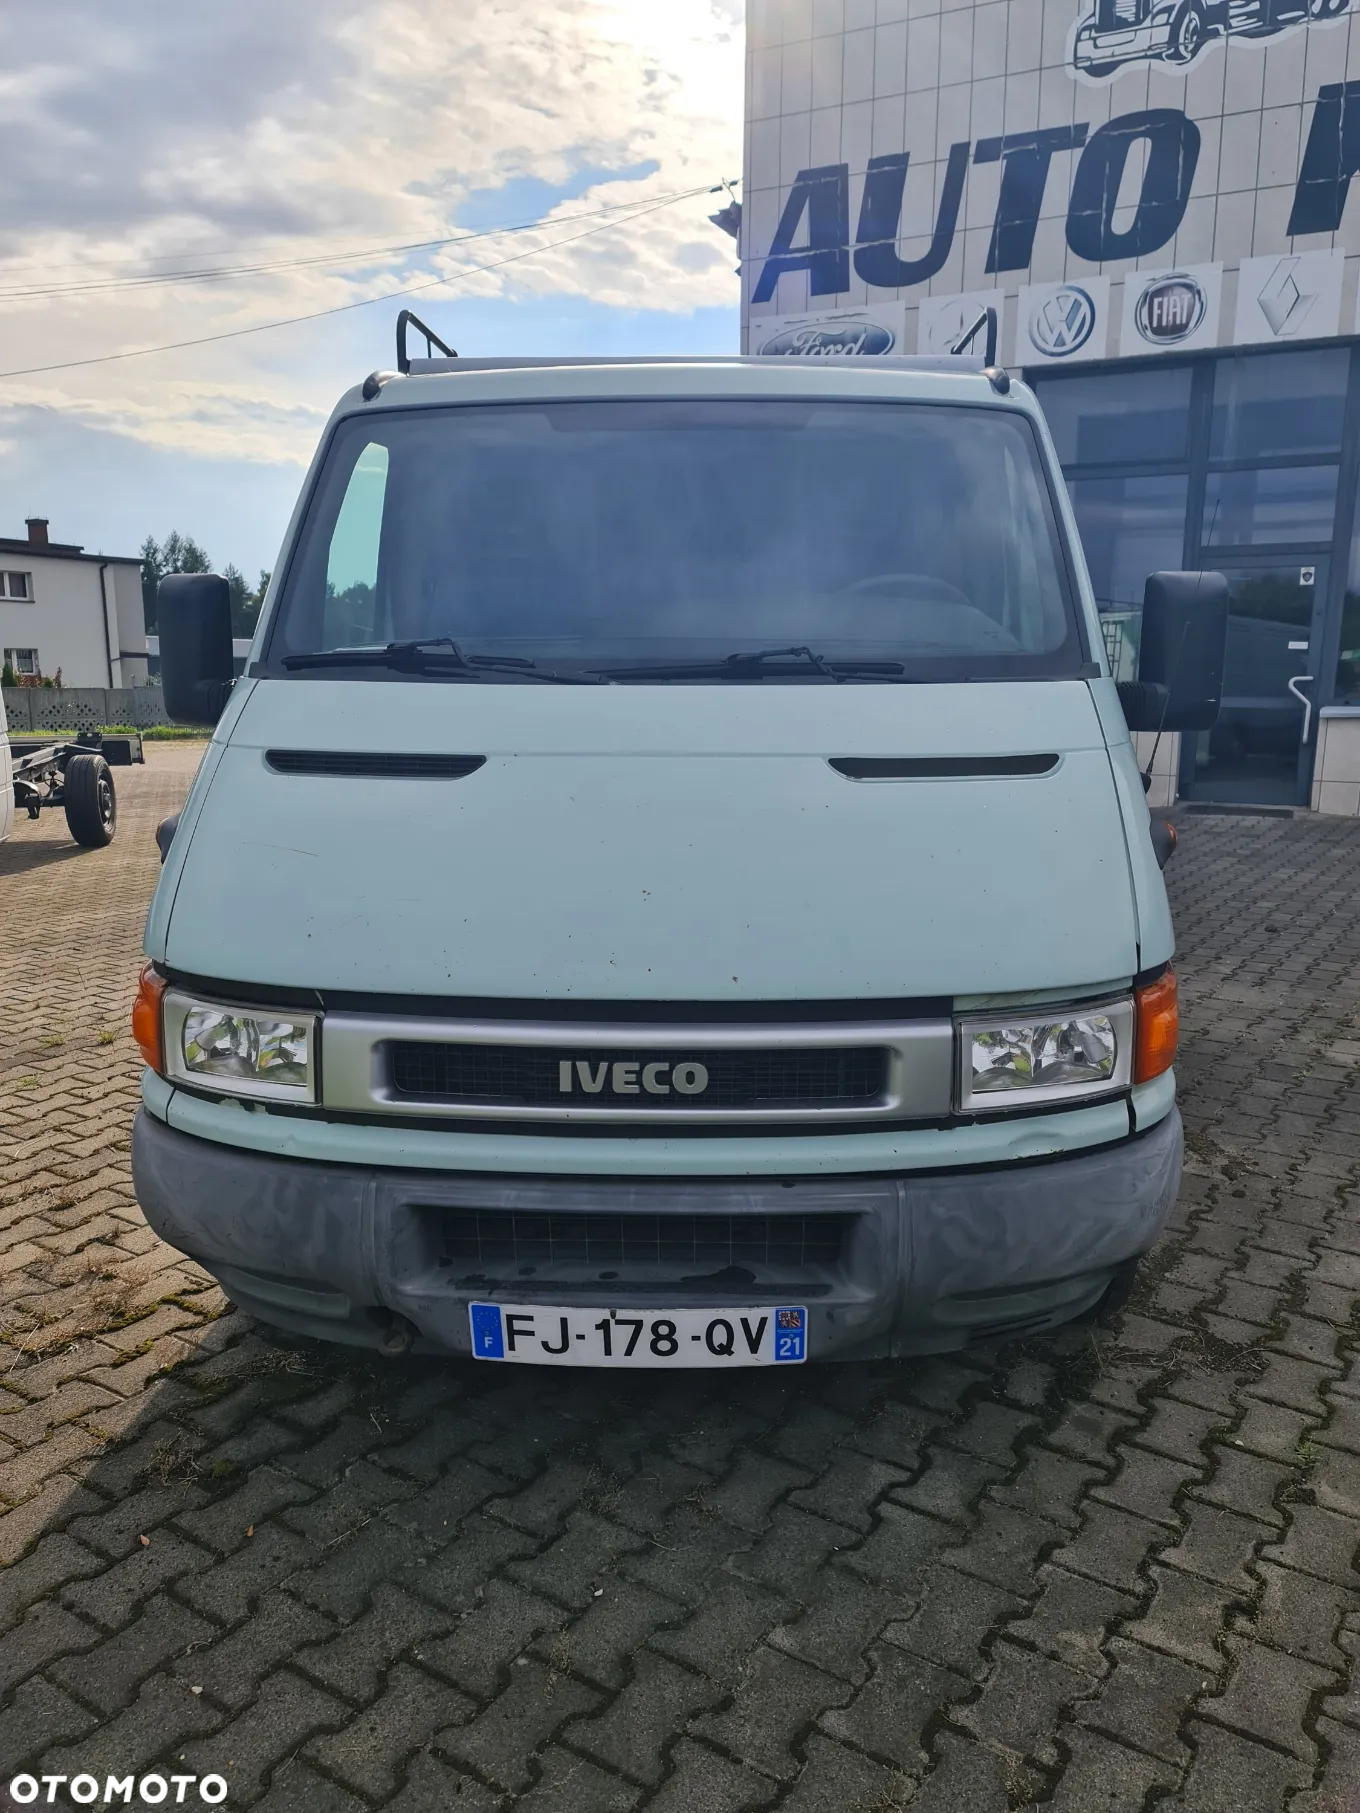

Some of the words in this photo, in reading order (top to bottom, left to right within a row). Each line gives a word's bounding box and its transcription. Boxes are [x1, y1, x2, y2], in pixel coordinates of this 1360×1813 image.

[751, 108, 1202, 304] AUTO
[1152, 294, 1192, 328] FIAT
[559, 1061, 709, 1094] IVECO
[484, 1336, 493, 1348] F
[780, 1337, 800, 1356] 21
